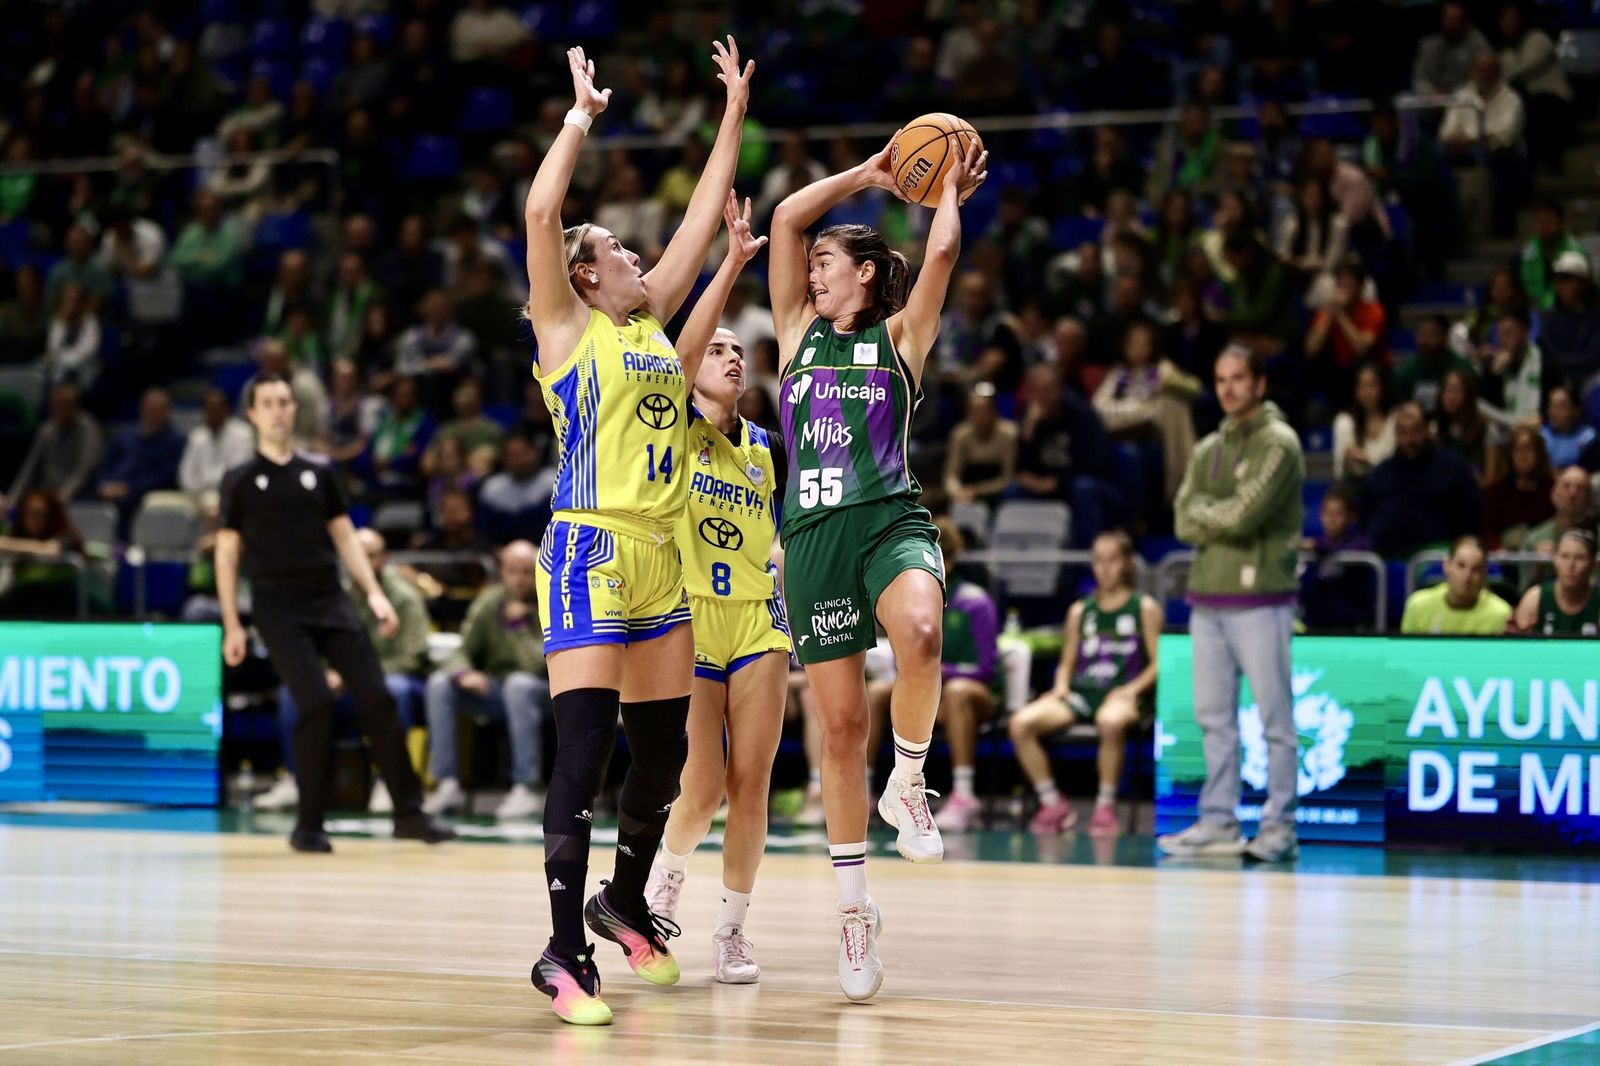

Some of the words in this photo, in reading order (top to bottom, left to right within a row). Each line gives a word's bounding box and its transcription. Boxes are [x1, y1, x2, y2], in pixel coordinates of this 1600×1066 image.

[901, 157, 934, 193] Wilso
[623, 351, 683, 376] ADAREV
[815, 382, 886, 405] Unicaja
[800, 416, 853, 454] Mijas
[646, 443, 673, 484] 14
[688, 491, 763, 520] TENERIFE
[690, 471, 764, 511] ADAREVA
[800, 467, 844, 509] 55
[711, 561, 732, 597] 8
[604, 609, 623, 617] vive
[814, 597, 852, 611] CLINICAS
[820, 632, 854, 647] DENTAL
[1406, 676, 1598, 741] AYUN
[1408, 750, 1498, 813] DE
[1519, 752, 1600, 816] MI
